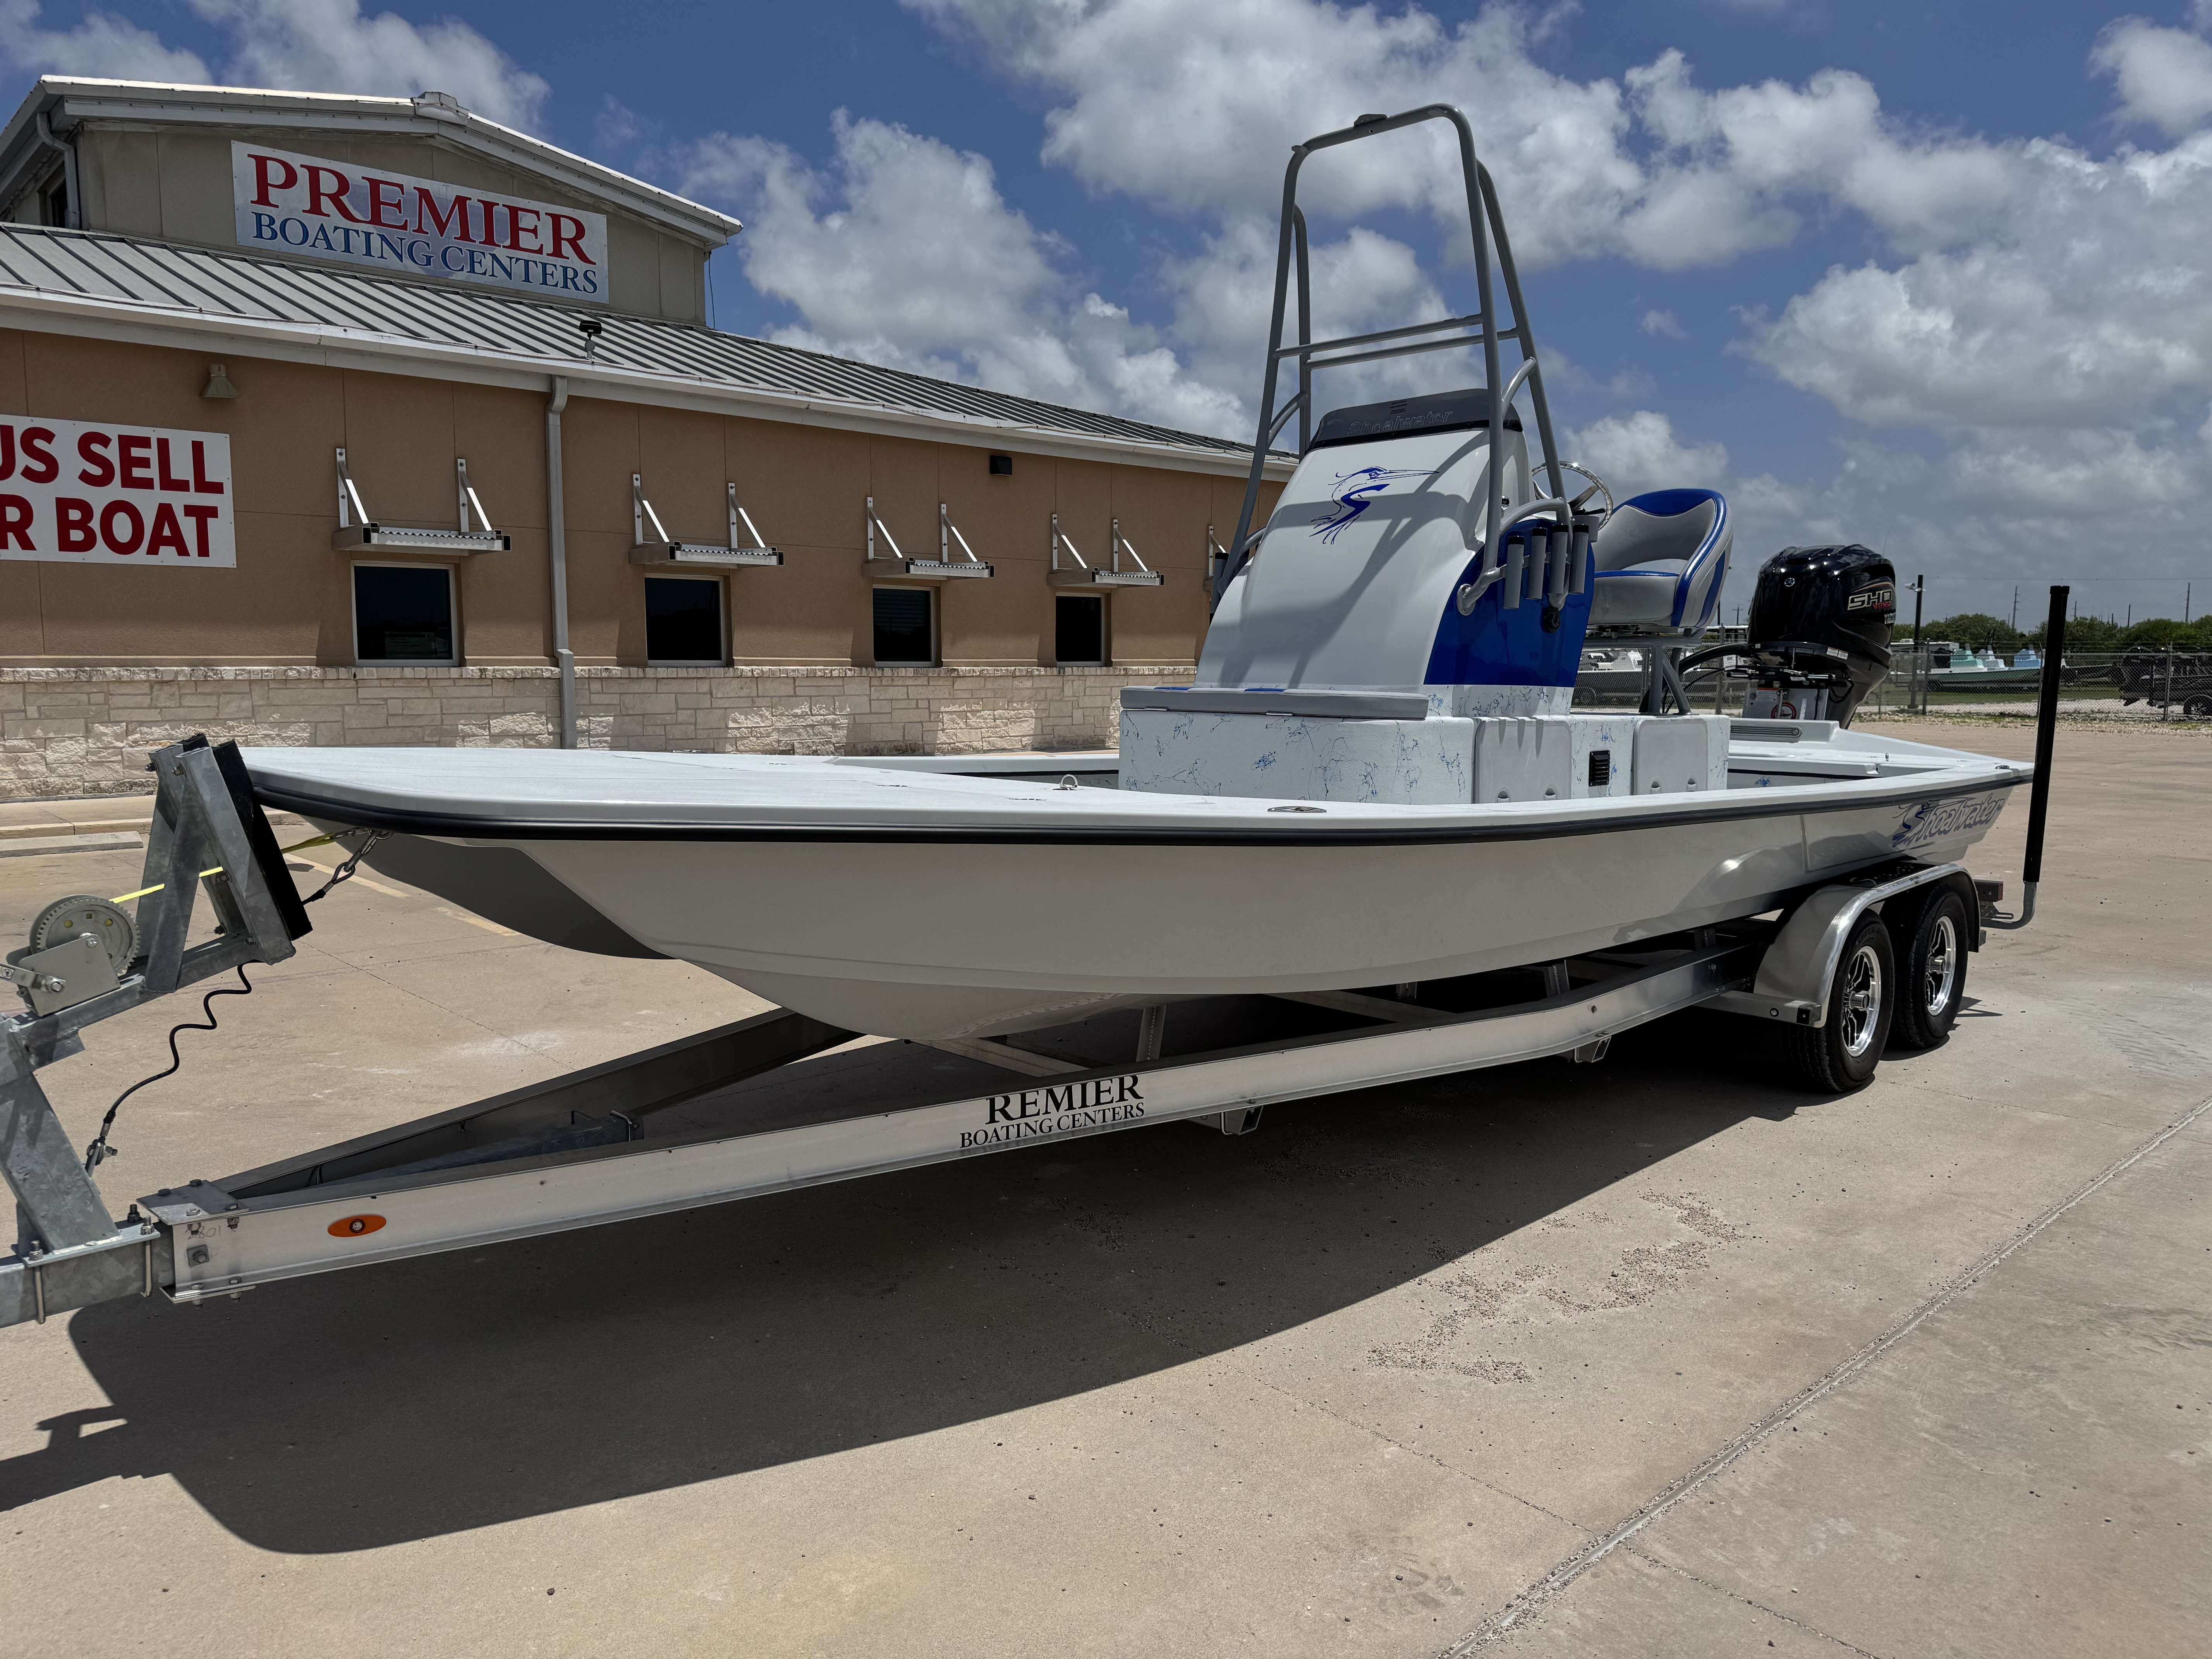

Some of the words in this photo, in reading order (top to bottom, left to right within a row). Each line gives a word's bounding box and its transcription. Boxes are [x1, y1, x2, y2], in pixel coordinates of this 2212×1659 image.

[247, 153, 596, 266] PREMIER
[251, 211, 434, 267] BOATING
[440, 246, 598, 294] CENTERS
[1348, 411, 1453, 436] Shoalwater
[77, 431, 224, 495] SELL
[55, 497, 219, 558] BOAT
[1847, 589, 1893, 611] SHO
[959, 1118, 1054, 1149] BOATING
[1057, 1102, 1145, 1131] CENTERS
[985, 1074, 1144, 1125] REMIER
